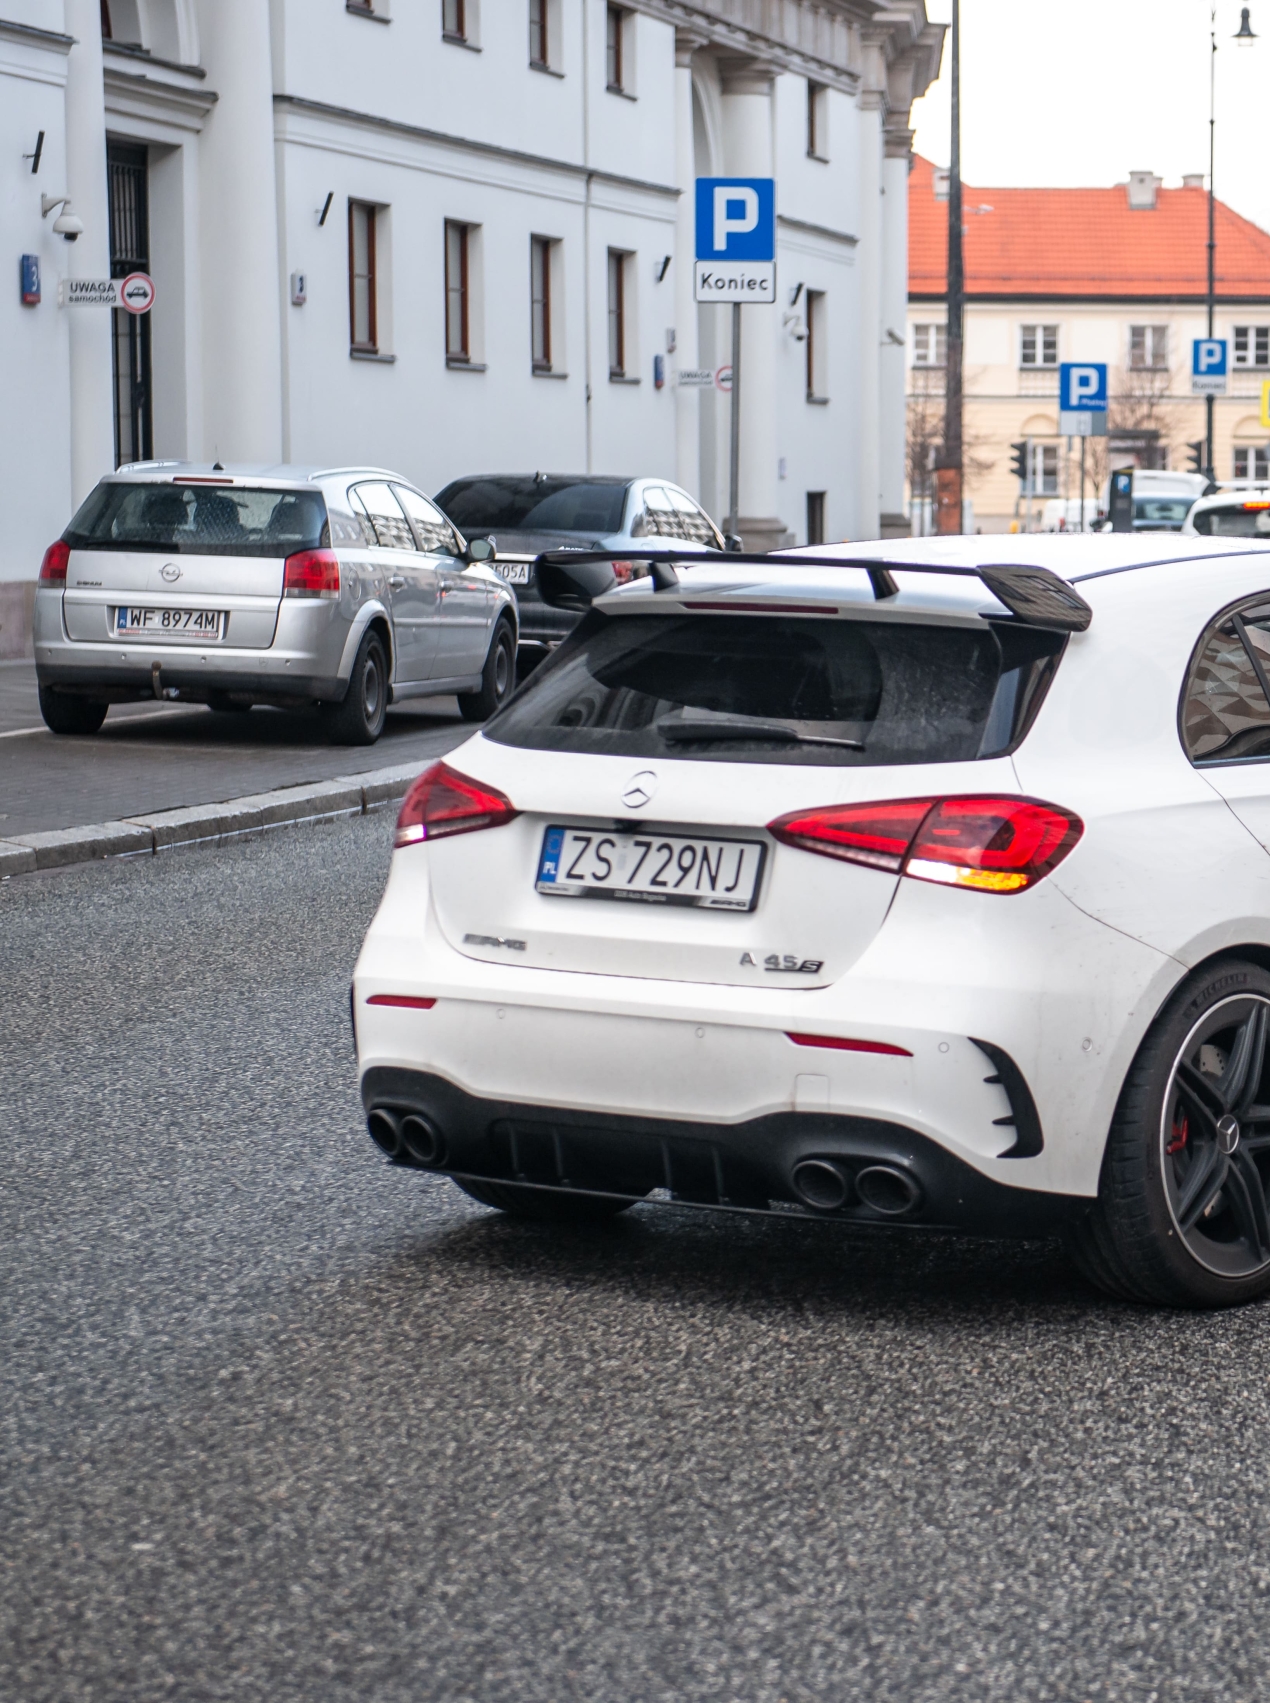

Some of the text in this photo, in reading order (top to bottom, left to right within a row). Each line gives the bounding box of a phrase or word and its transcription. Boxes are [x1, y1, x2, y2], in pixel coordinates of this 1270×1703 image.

[713, 186, 759, 251] P
[31, 266, 38, 292] 3
[70, 282, 115, 293] UWAGA
[701, 273, 769, 291] Koniec
[68, 294, 117, 304] samochód
[1199, 343, 1222, 372] P
[1069, 367, 1099, 406] P
[490, 563, 526, 580] 505A
[131, 609, 216, 630] WF 8974M
[543, 862, 556, 874] PL
[565, 835, 745, 892] ZS 729NJ
[740, 952, 757, 967] A
